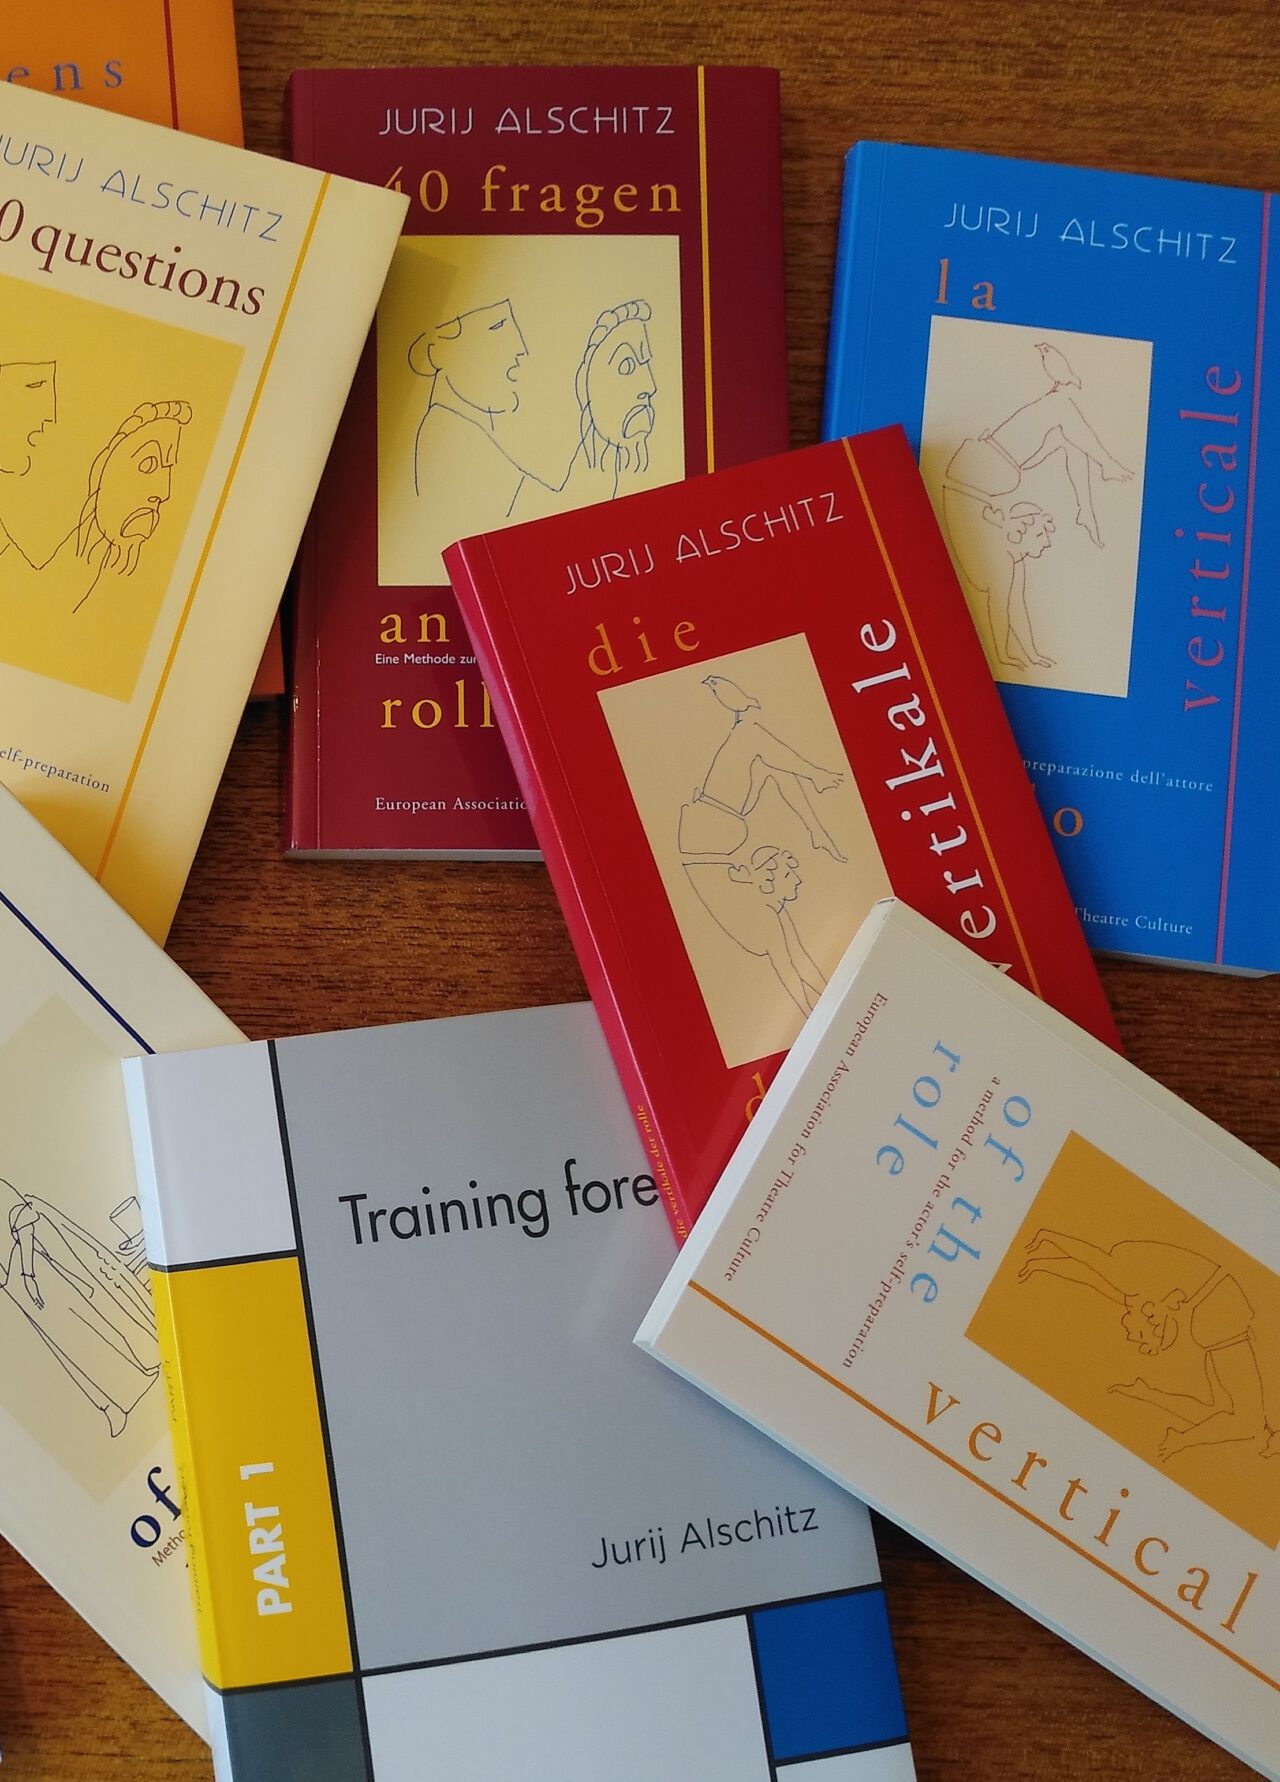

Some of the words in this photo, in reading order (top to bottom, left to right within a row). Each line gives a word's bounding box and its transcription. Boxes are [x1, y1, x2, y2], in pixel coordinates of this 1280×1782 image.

[379, 107, 474, 135] JURIJ
[495, 106, 676, 134] ALSCHITZ
[100, 169, 284, 242] ALSCHITZ
[481, 165, 682, 229] fragen
[944, 203, 1039, 238] JURIJ
[1059, 217, 1237, 265] ALSCHITZ
[31, 222, 266, 316] questions
[935, 258, 997, 311] la
[566, 543, 655, 595] JURIJ
[675, 492, 844, 564] ALSCHITZ
[1173, 364, 1243, 713] verticale
[375, 653, 400, 665] Eine
[403, 653, 456, 665] Methode
[379, 612, 450, 644] an
[587, 616, 700, 676] die
[375, 797, 446, 814] European
[1134, 915, 1193, 936] Culture
[844, 991, 890, 1057] European
[801, 1059, 852, 1140] Association
[875, 1039, 962, 1177] role
[960, 1089, 995, 1147] method
[786, 1142, 808, 1167] for
[946, 1145, 968, 1171] for
[984, 1094, 1033, 1184] of
[338, 1180, 551, 1246] Training
[754, 1169, 796, 1223] Theatre
[931, 1173, 953, 1198] the
[723, 1226, 762, 1283] Culture
[909, 1196, 984, 1304] the
[841, 1250, 910, 1370] self-preparation
[239, 1461, 274, 1480] 1
[130, 1466, 182, 1548] of
[591, 1527, 667, 1569] Jurij
[679, 1504, 820, 1554] Alschitz
[919, 1380, 1259, 1635] vertical
[244, 1502, 292, 1616] PART
